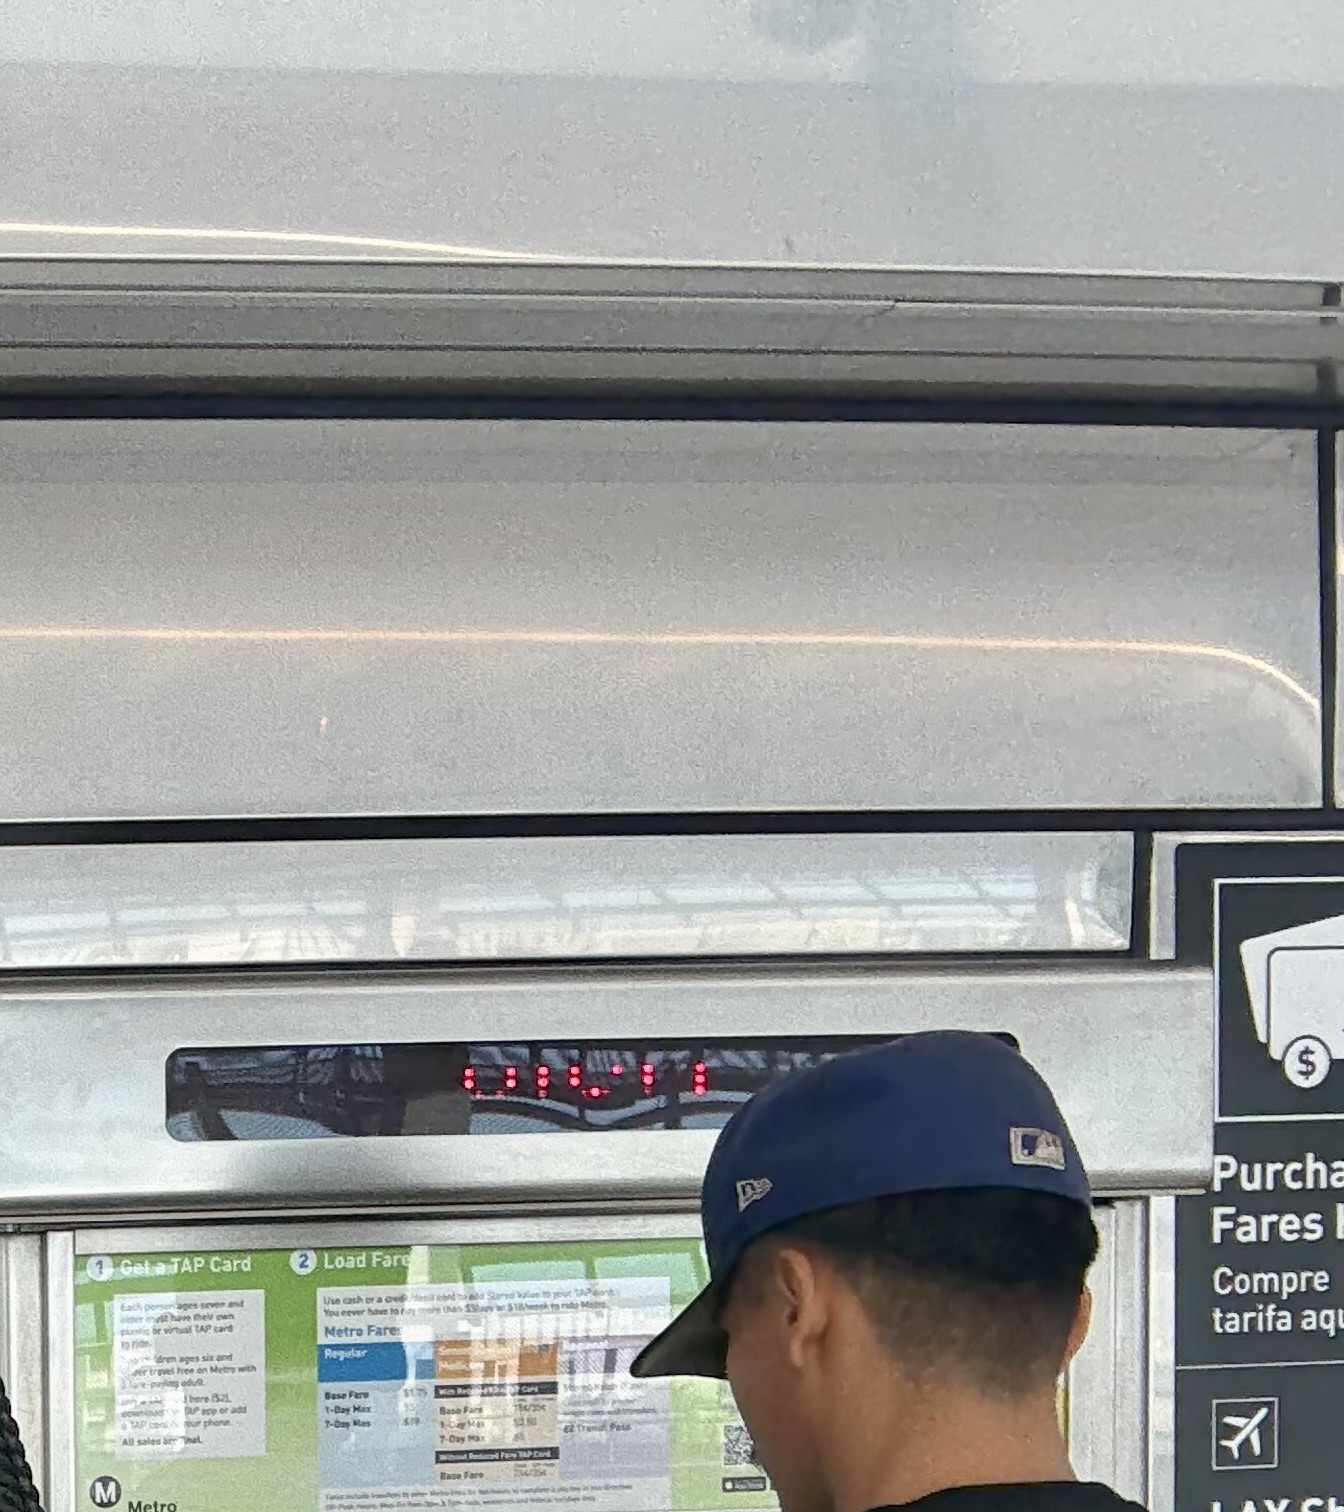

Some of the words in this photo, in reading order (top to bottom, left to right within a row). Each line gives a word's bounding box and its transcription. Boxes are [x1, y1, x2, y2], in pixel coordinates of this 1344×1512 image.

[1212, 1152, 1344, 1192] Purcha
[1212, 1205, 1324, 1244] Fares
[121, 1258, 152, 1275] Get
[154, 1261, 165, 1273] a
[170, 1256, 205, 1273] TAP
[210, 1256, 252, 1273] Card
[323, 1251, 366, 1270] Load
[371, 1251, 412, 1268] Fare
[1213, 1266, 1330, 1300] Compre
[176, 1301, 198, 1312] ages
[227, 1299, 244, 1308] and
[323, 1296, 341, 1305] Use
[342, 1295, 363, 1304] cash
[170, 1313, 191, 1322] have
[193, 1312, 214, 1321] their
[216, 1313, 235, 1321] own
[323, 1308, 340, 1317] You
[341, 1308, 365, 1317] never
[367, 1307, 389, 1316] have
[1212, 1302, 1293, 1334] tarifa
[164, 1325, 193, 1335] virtual
[195, 1325, 212, 1333] TAP
[213, 1324, 234, 1333] card
[324, 1325, 363, 1338] Metro
[178, 1355, 200, 1365] ages
[201, 1353, 214, 1362] six
[216, 1353, 233, 1362] and
[324, 1347, 368, 1360] Regular
[176, 1367, 194, 1376] free
[197, 1367, 208, 1375] on
[210, 1365, 236, 1374] Metro
[237, 1364, 257, 1374] with
[324, 1391, 347, 1400] Base
[348, 1390, 370, 1399] Fare
[184, 1407, 200, 1416] TAP
[201, 1407, 218, 1417] app
[219, 1406, 230, 1414] or
[231, 1405, 248, 1414] add
[325, 1406, 351, 1416] 1-Day
[352, 1405, 372, 1414] Max
[439, 1406, 462, 1415] Base
[463, 1405, 483, 1414] Fare
[352, 1419, 372, 1428] Max
[121, 1438, 135, 1447] All
[136, 1436, 161, 1446] sales
[439, 1434, 466, 1445] 7-Day
[440, 1471, 462, 1481] Base
[463, 1470, 484, 1480] Fare
[94, 1481, 117, 1504] M
